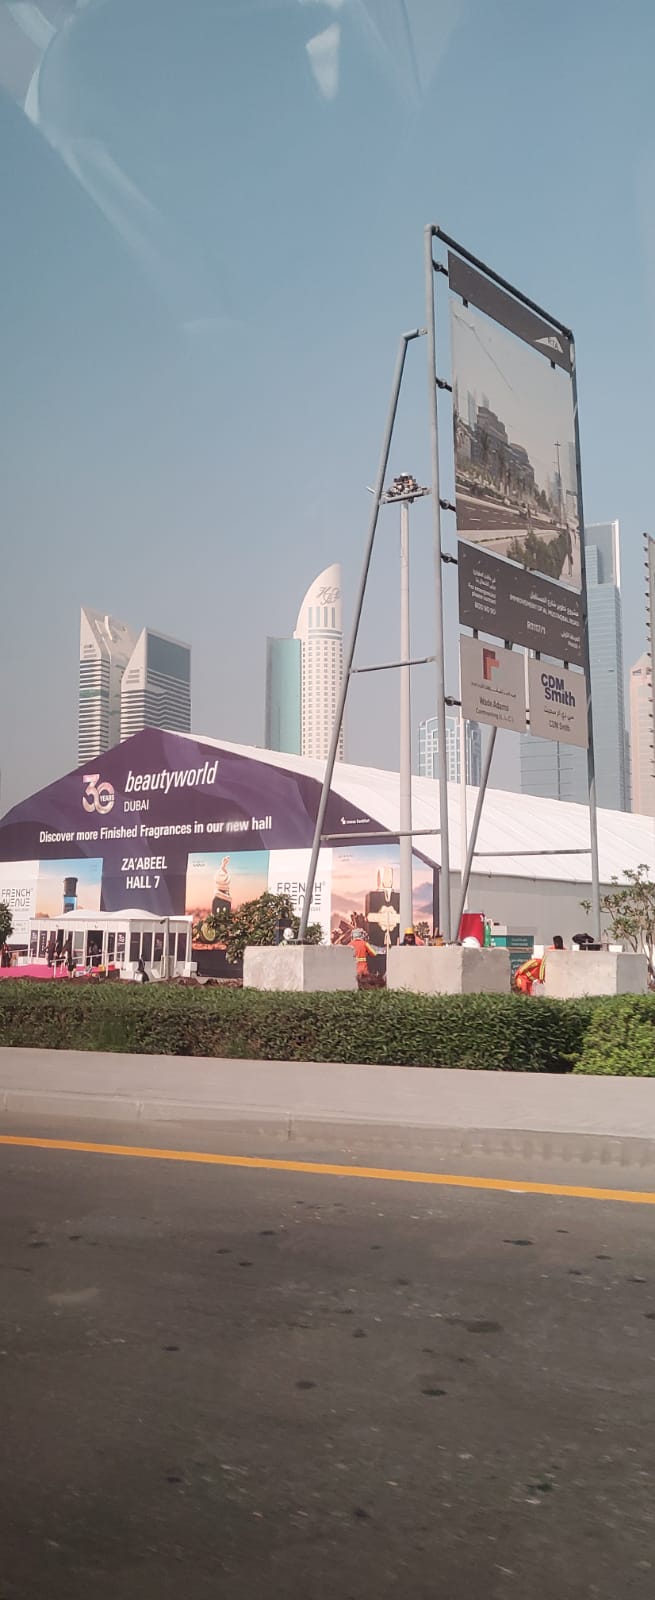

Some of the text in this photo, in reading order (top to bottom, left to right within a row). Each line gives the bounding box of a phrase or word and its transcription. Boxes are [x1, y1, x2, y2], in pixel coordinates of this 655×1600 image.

[541, 673, 565, 690] CDM
[545, 687, 576, 707] Smith
[125, 760, 219, 794] beautyworld
[82, 774, 115, 814] 30
[124, 800, 149, 812] DUBAI
[40, 816, 272, 843] Discover more Finished Fragrances in our new hall
[126, 876, 160, 889] HALL 7
[276, 882, 322, 893] FRENH
[1, 888, 31, 898] FRENCH
